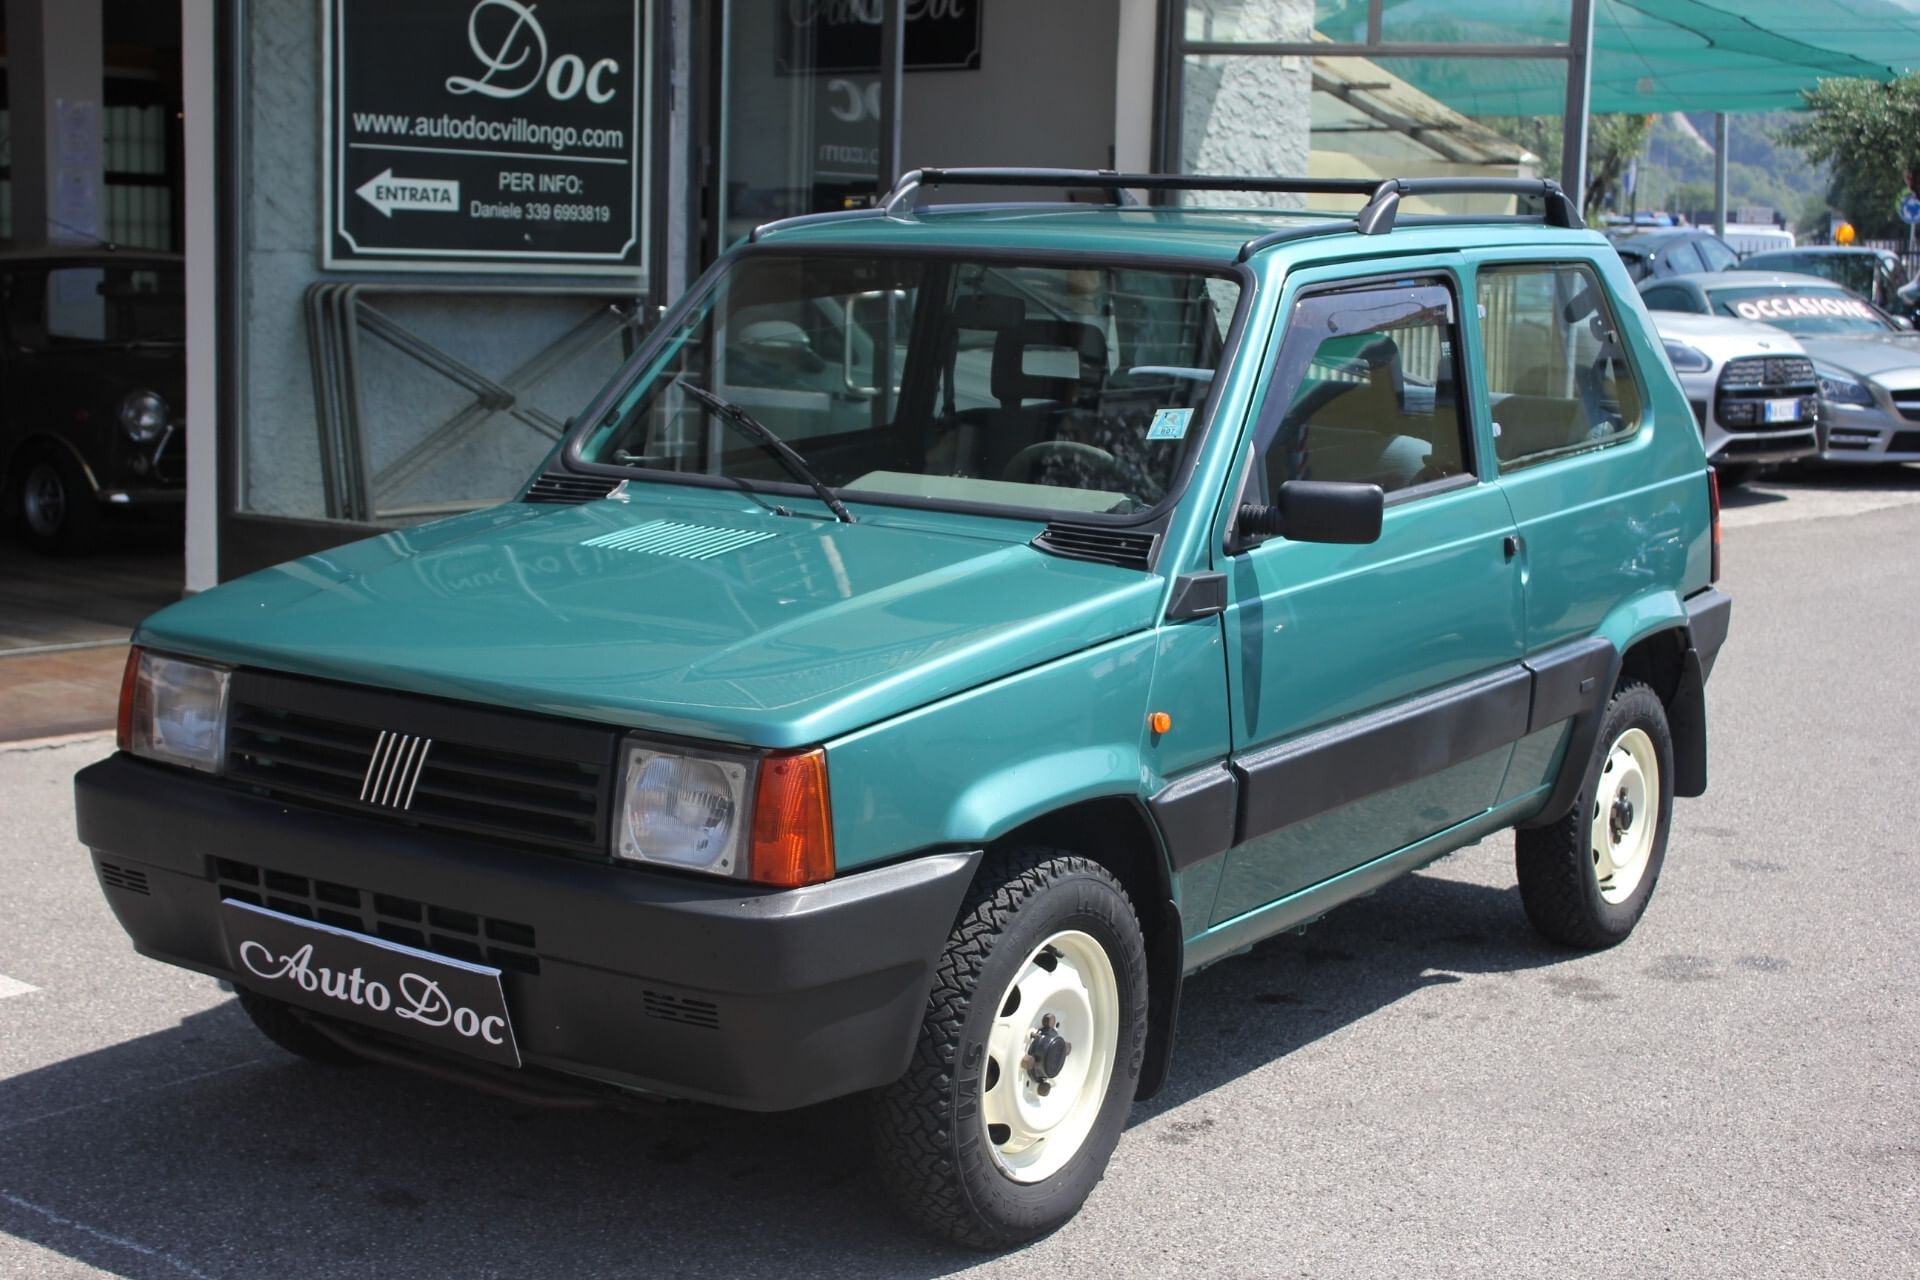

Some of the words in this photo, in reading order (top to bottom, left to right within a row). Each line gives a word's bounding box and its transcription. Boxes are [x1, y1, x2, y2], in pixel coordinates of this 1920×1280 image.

[445, 0, 619, 104] Doc
[353, 112, 623, 151] www.autodocvillongo.com
[375, 184, 452, 204] ENTRATA
[499, 172, 535, 192] PER
[539, 174, 583, 194] INFO:
[470, 200, 522, 219] Daniele
[525, 203, 550, 220] 339
[553, 203, 610, 223] 6993819
[1737, 298, 1873, 320] OCCASIONE
[239, 940, 391, 1012] Auto
[395, 972, 505, 1045] Doc
